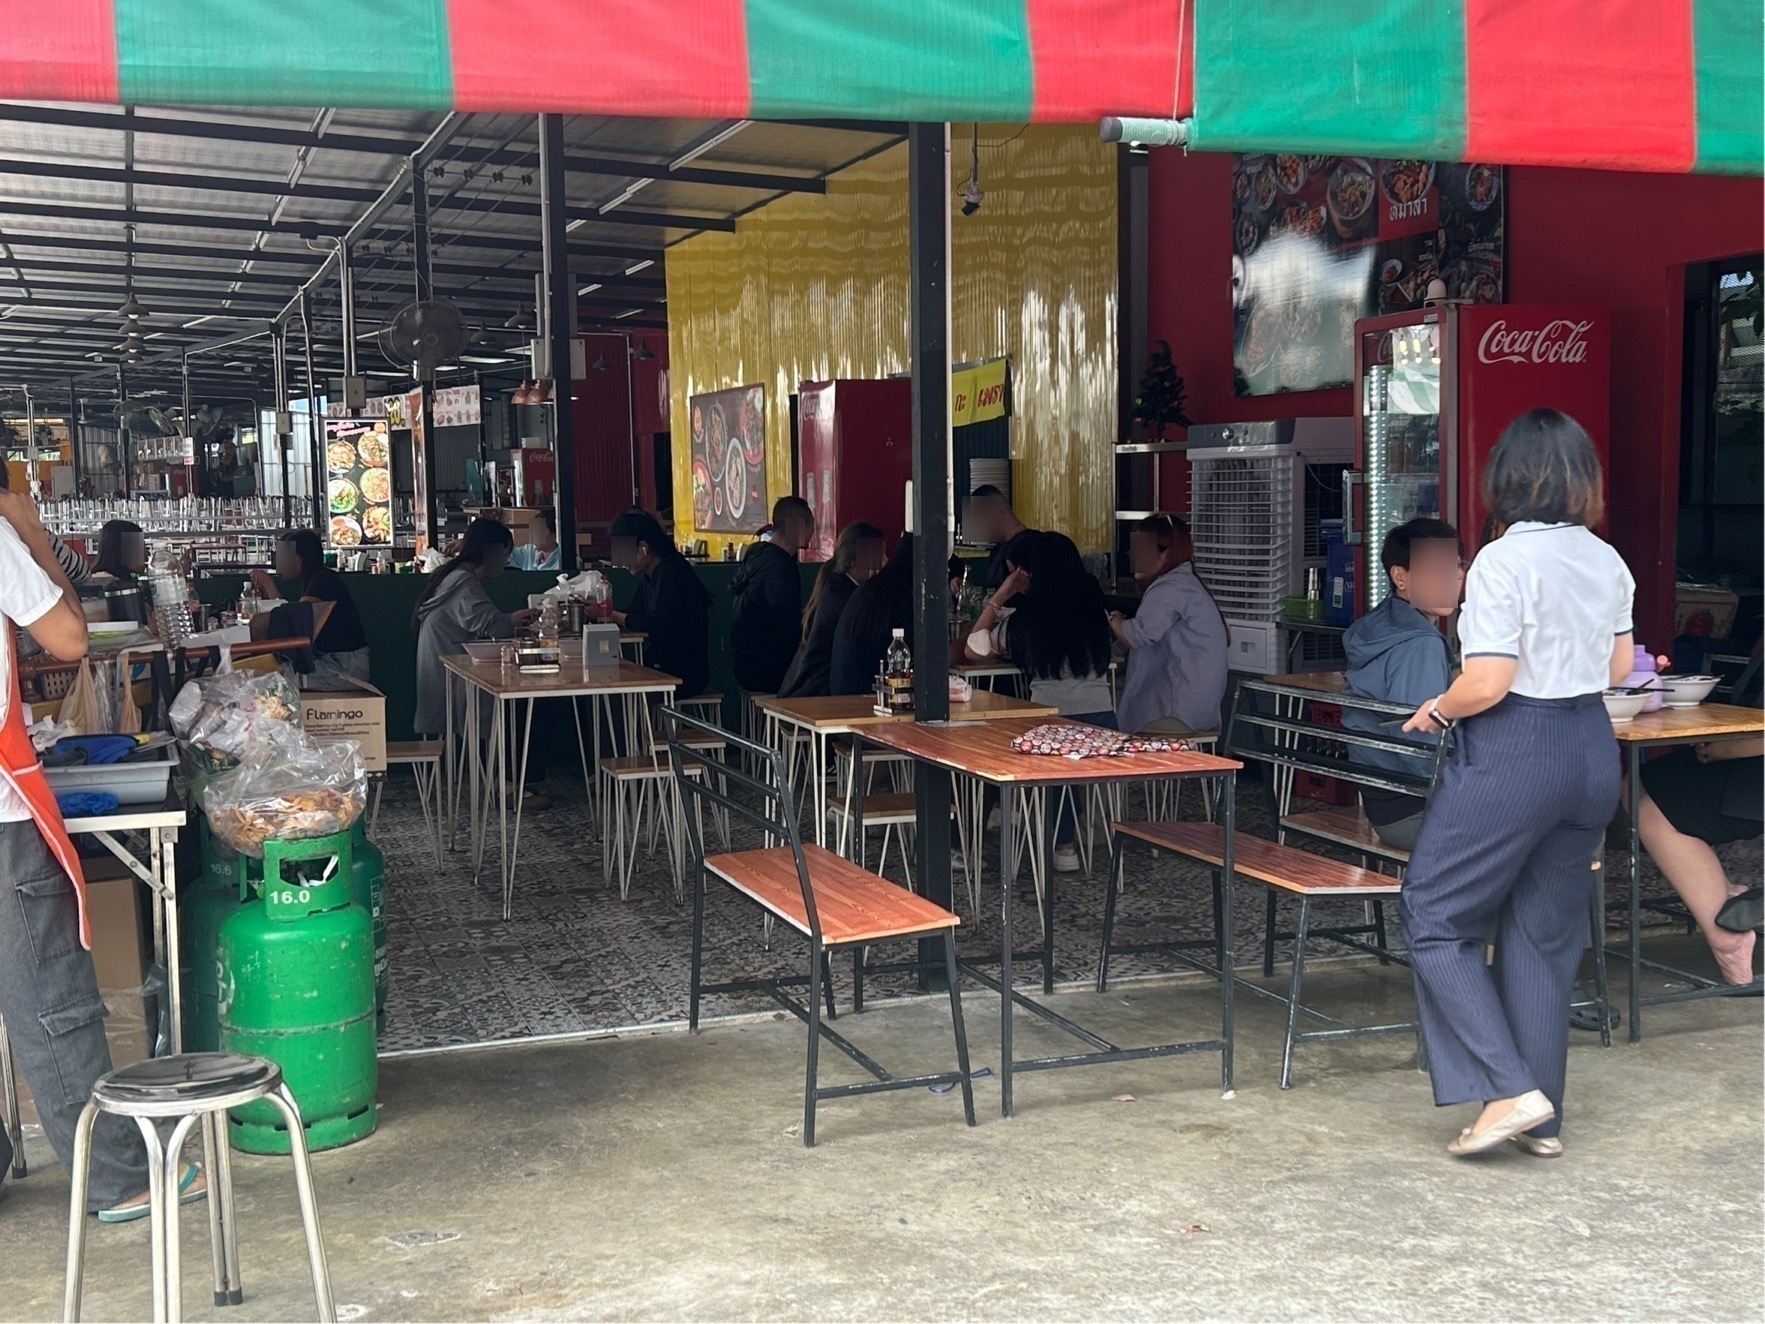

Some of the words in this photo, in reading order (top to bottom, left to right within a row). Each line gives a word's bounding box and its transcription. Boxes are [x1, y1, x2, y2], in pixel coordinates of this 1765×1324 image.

[1478, 320, 1594, 363] Coca-Cola
[210, 863, 232, 876] 16.6
[270, 890, 310, 904] 16.0
